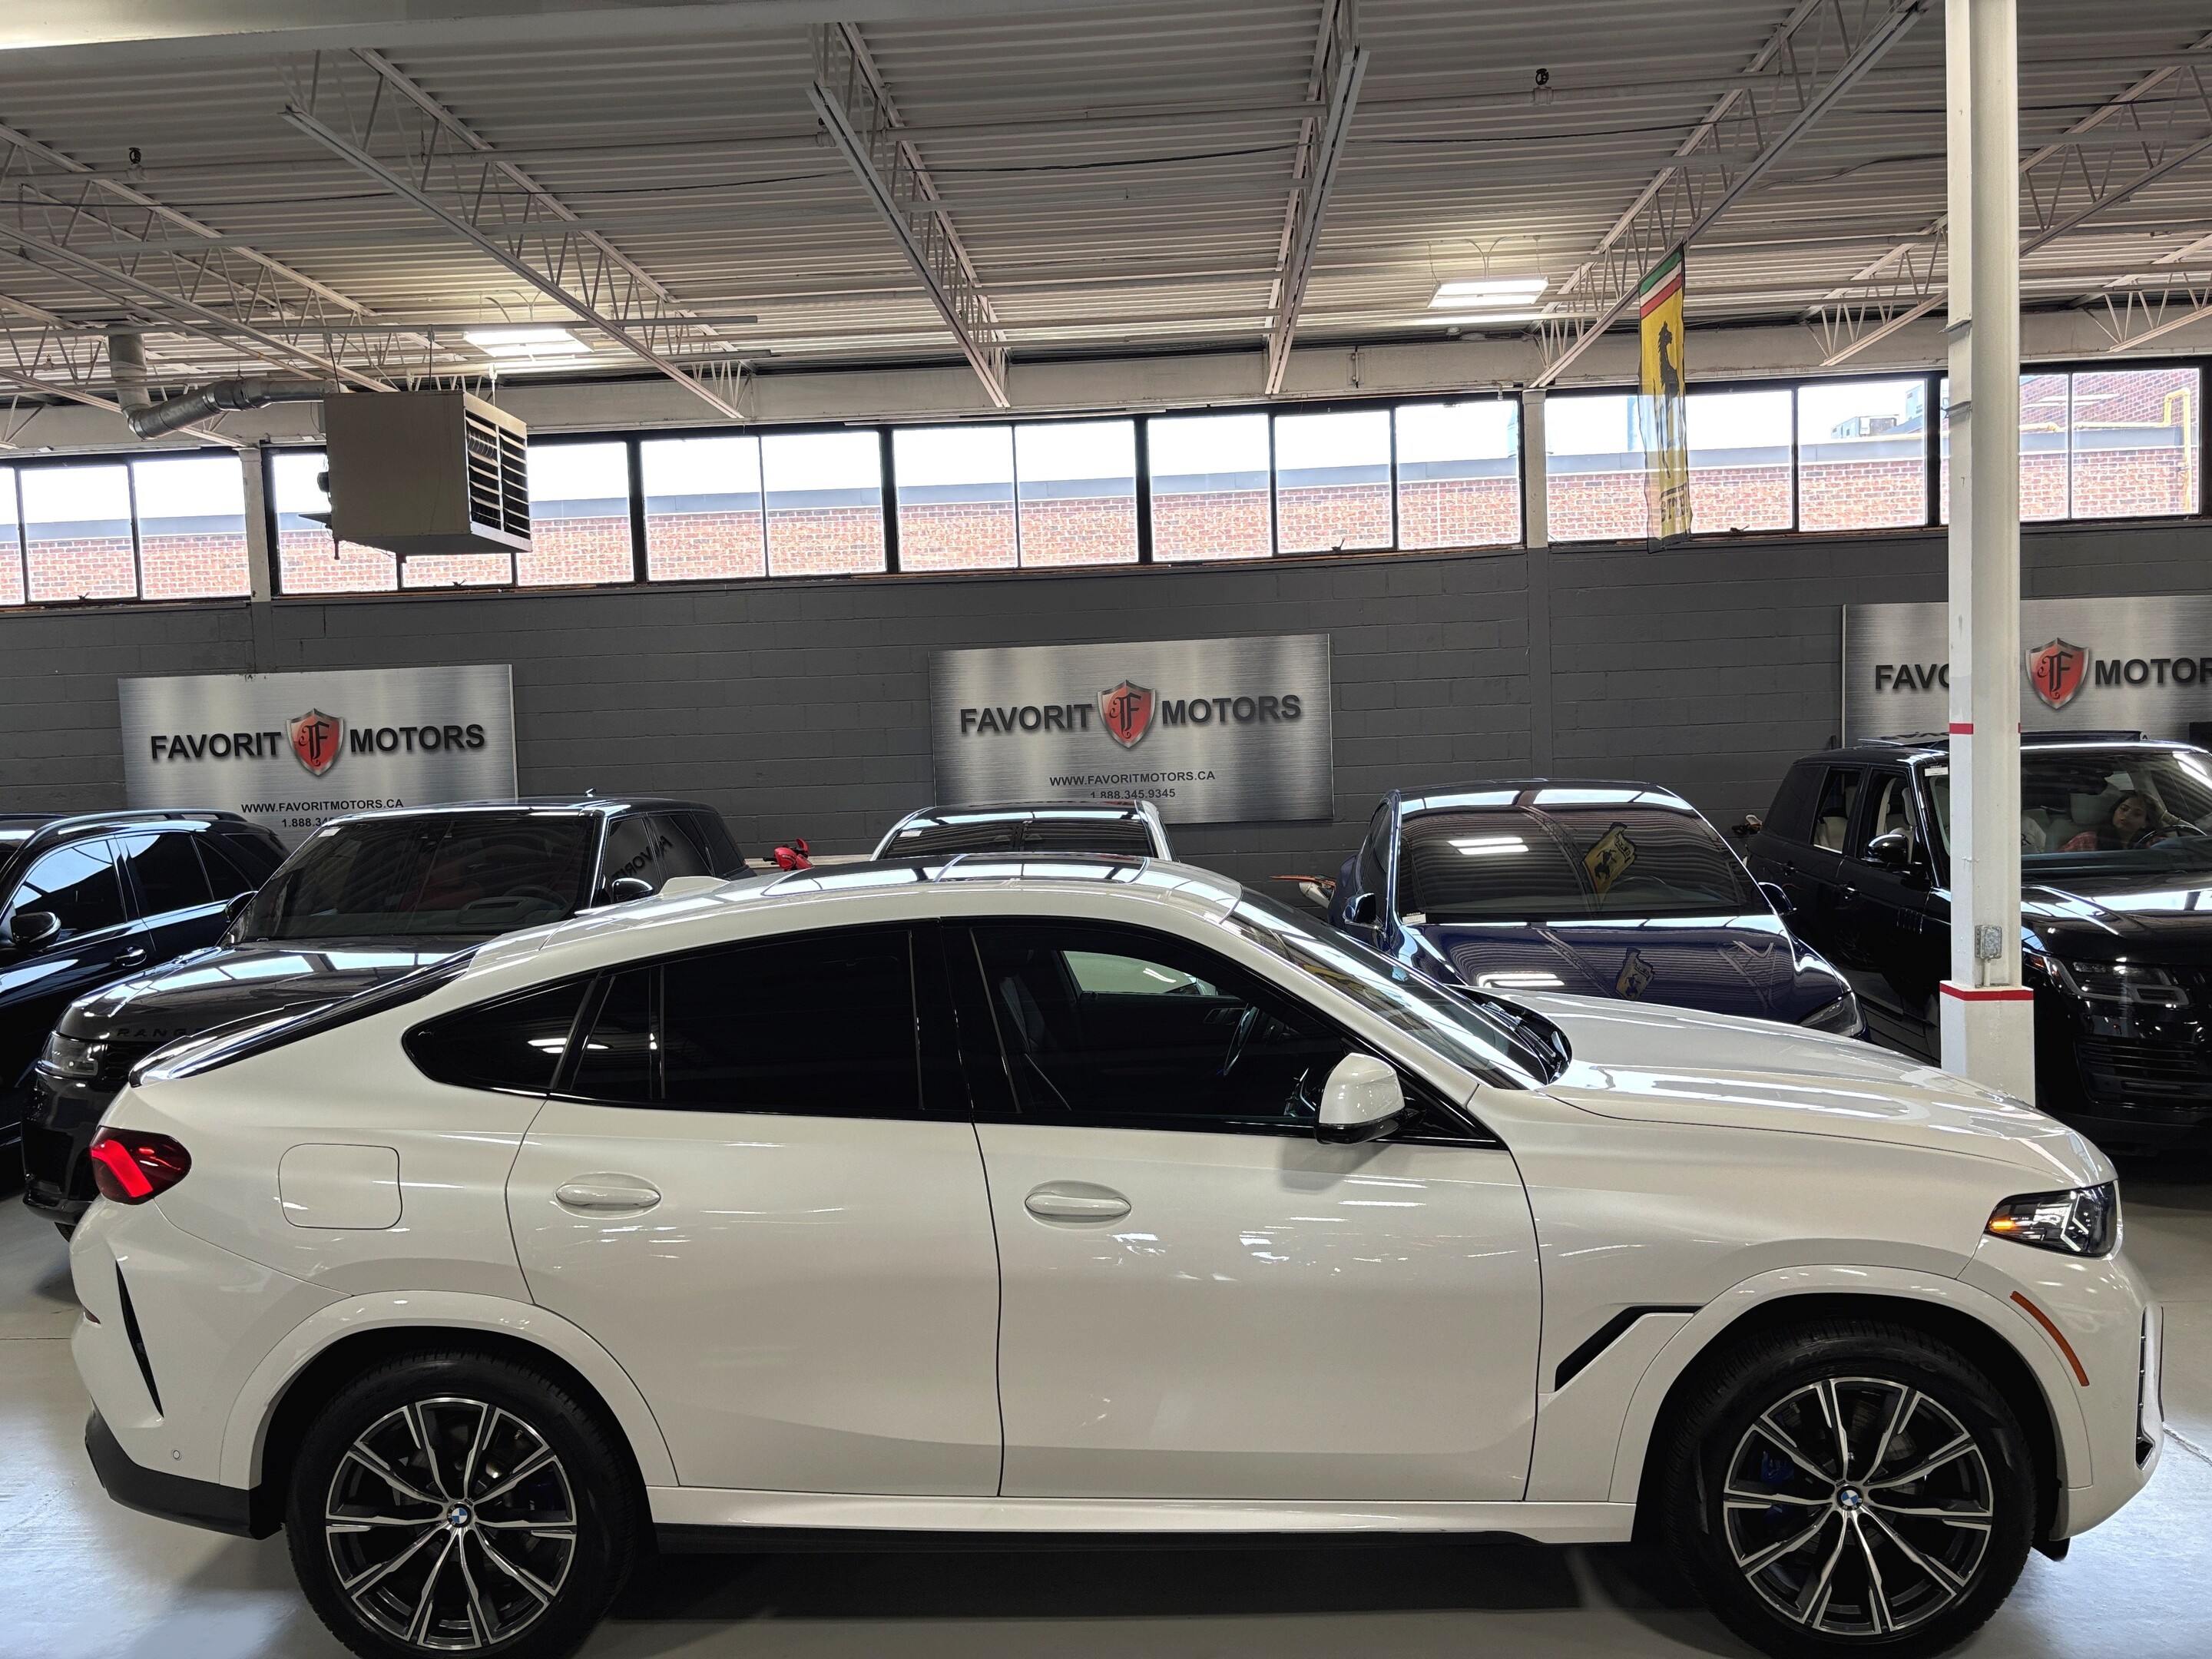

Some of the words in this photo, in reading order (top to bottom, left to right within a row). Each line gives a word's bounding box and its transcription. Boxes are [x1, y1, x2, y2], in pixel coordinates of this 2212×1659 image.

[960, 704, 1092, 733] FAVORIT
[1162, 694, 1302, 725] MOTORS
[150, 731, 282, 760] FAVORIT
[349, 724, 485, 753] MOTORS
[1049, 771, 1216, 786] WWW.FAVORITMOTORS.CA
[1091, 788, 1176, 800] 1888.345.9345
[241, 799, 404, 813] WWW.FAVORITMOTORS.CA
